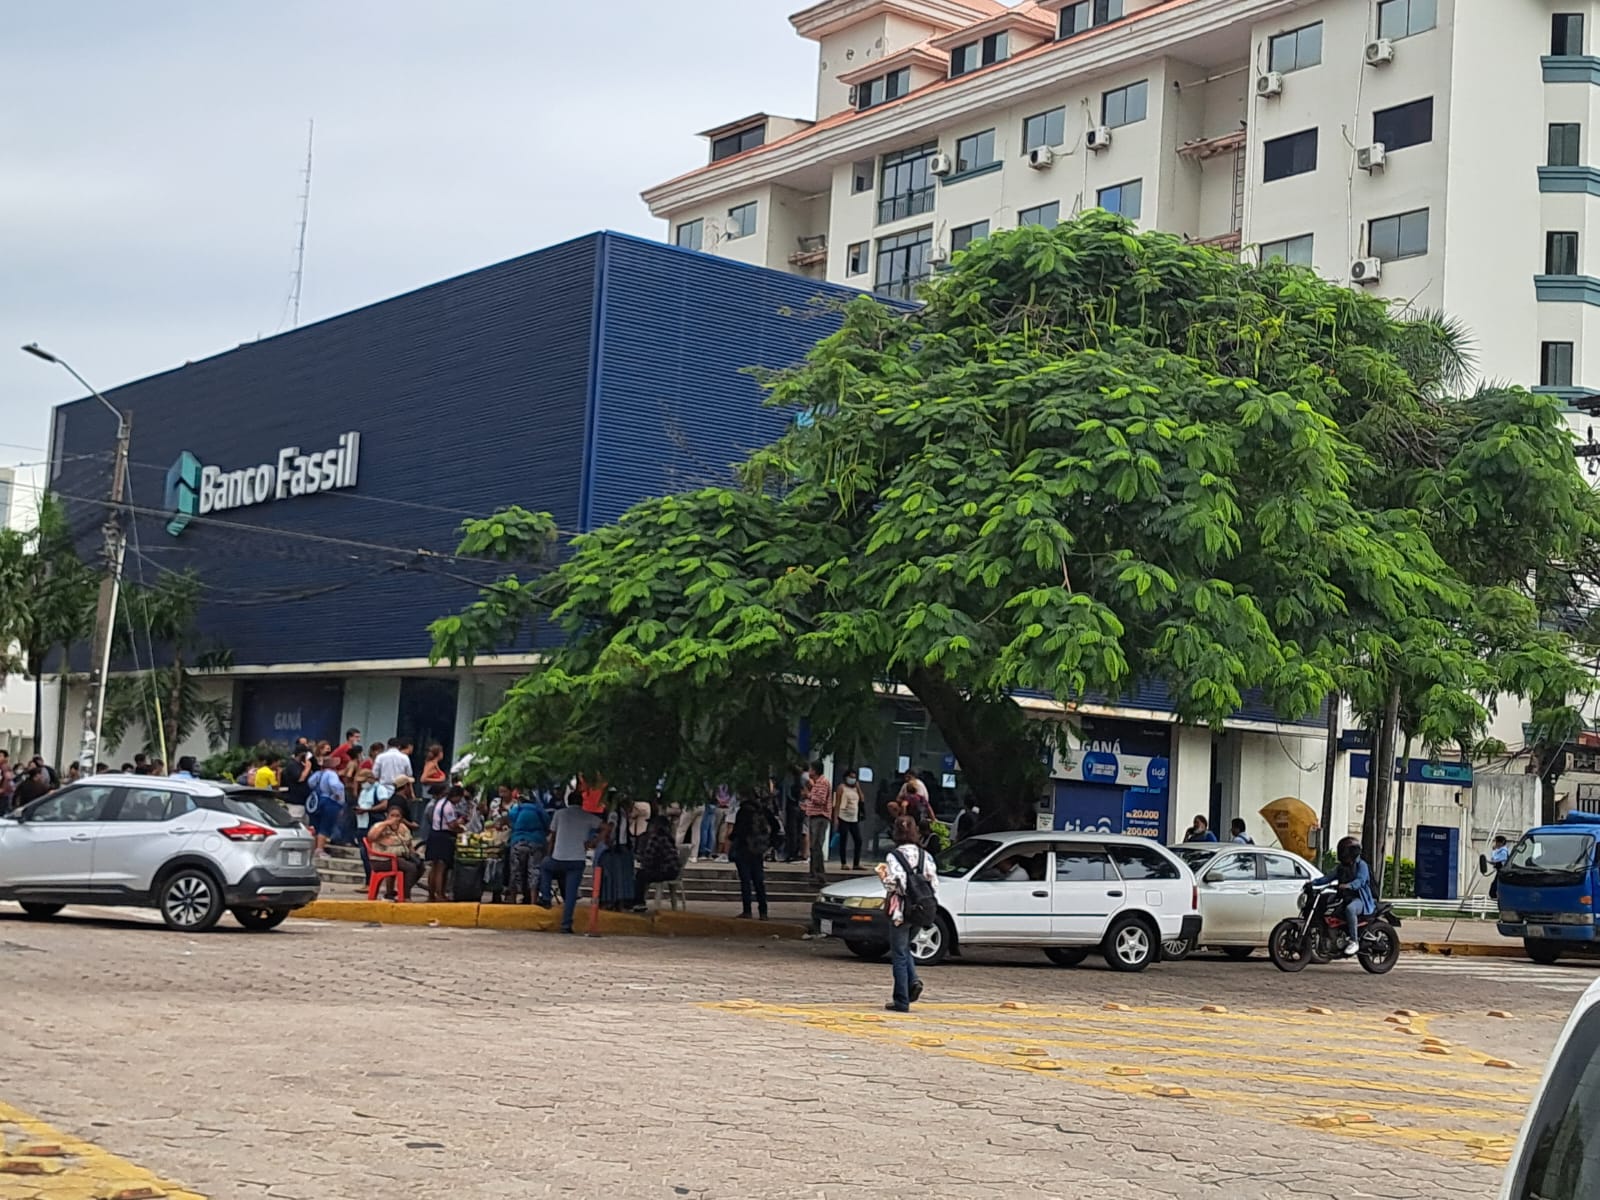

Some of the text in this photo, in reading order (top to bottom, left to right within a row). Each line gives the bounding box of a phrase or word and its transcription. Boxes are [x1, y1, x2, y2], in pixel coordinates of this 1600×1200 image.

[198, 431, 361, 514] Banco Fassil
[1081, 738, 1122, 754] GANÁ
